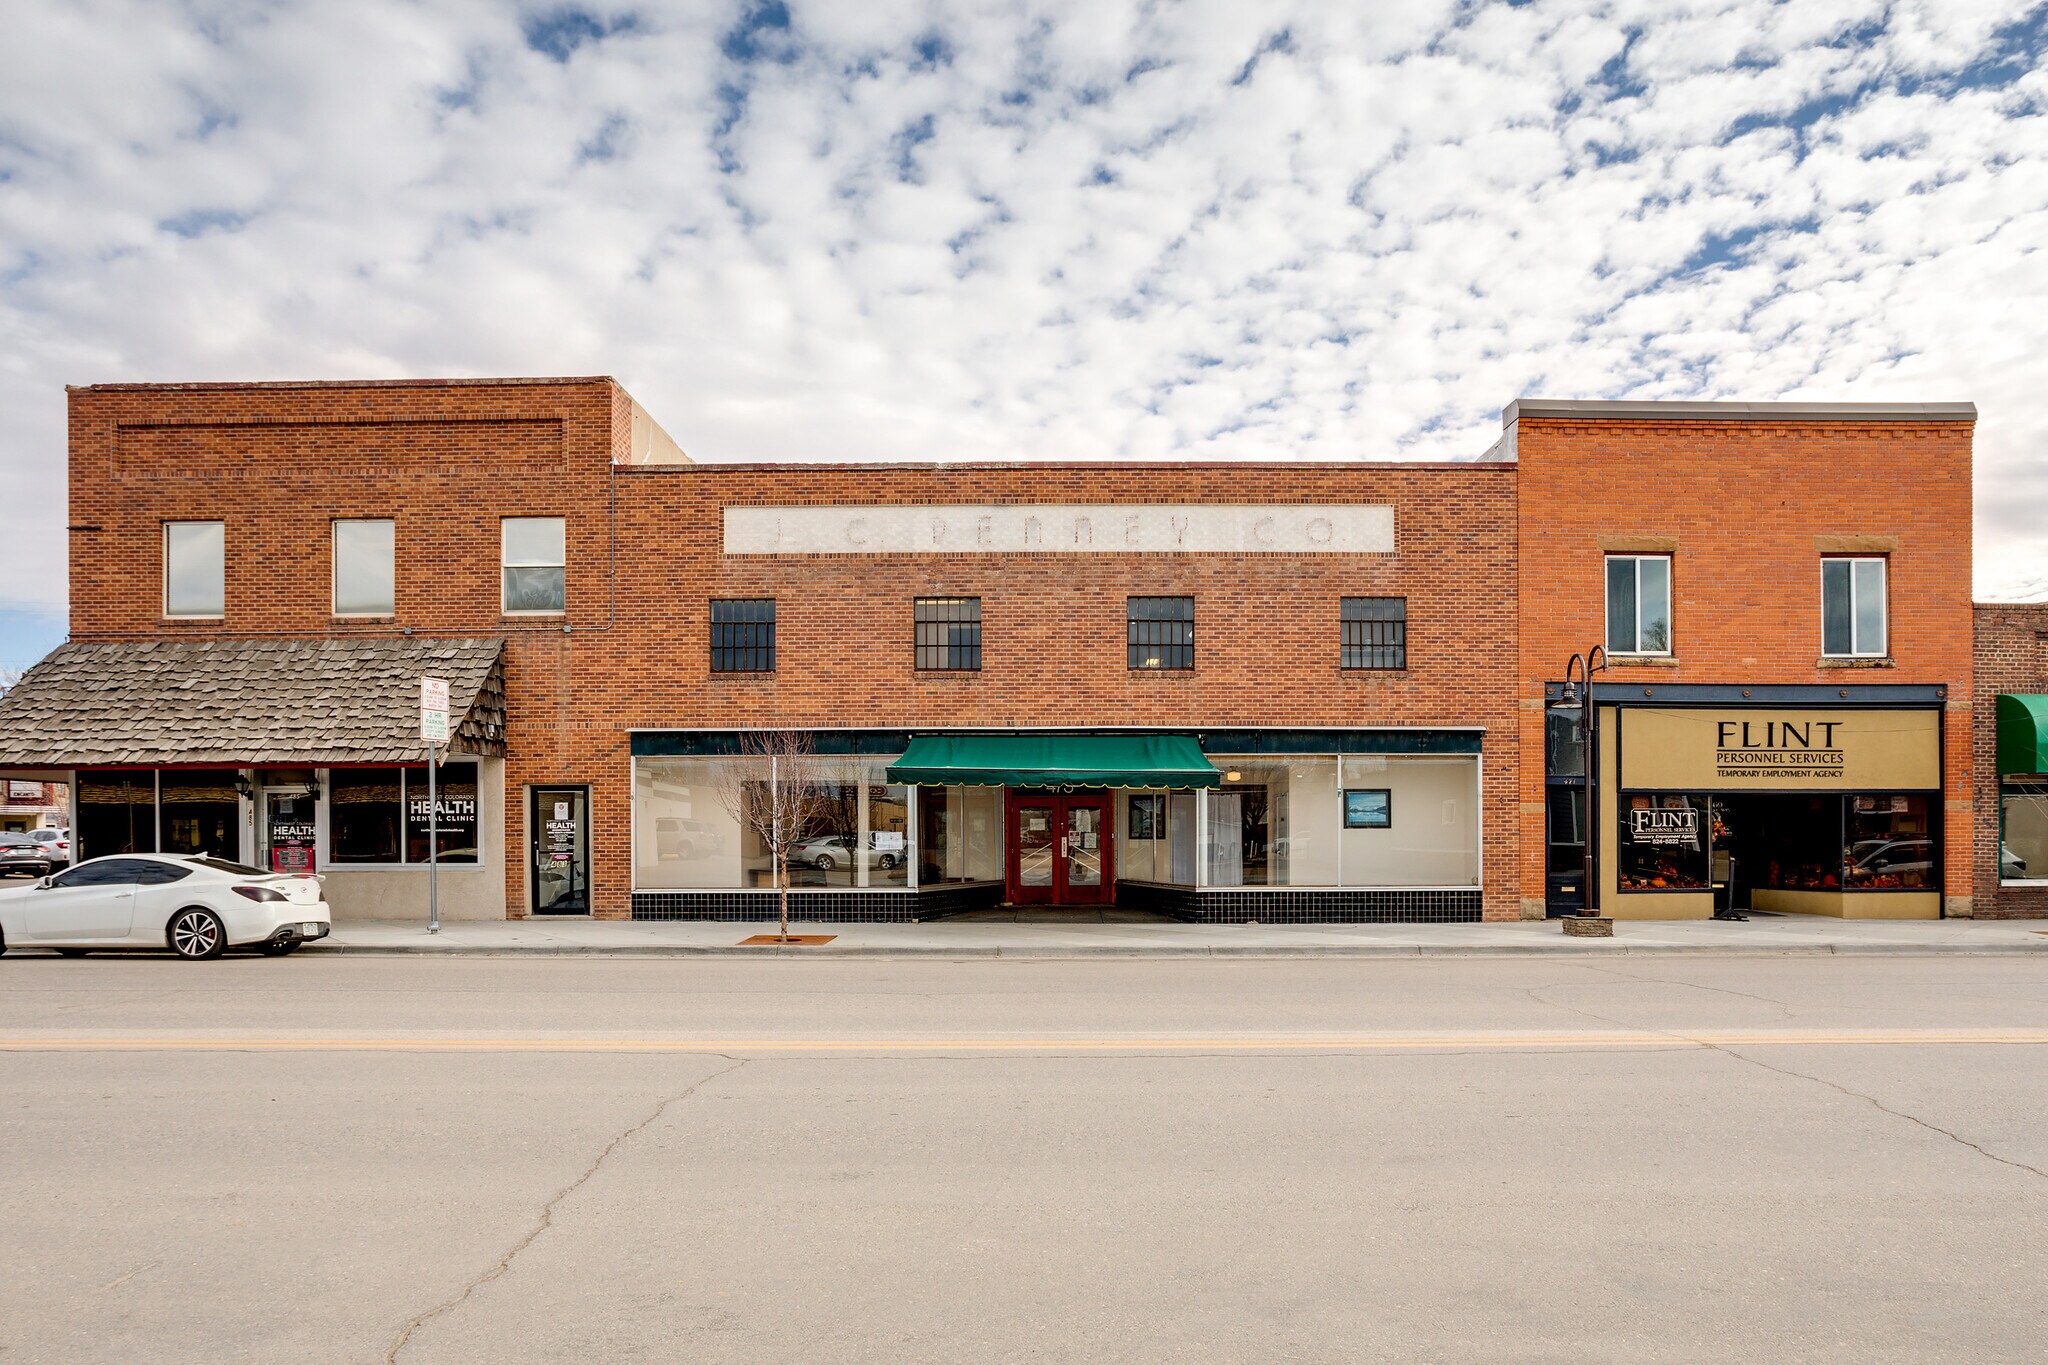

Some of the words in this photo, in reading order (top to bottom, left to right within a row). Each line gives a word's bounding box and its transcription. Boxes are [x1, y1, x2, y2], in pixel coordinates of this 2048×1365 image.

[930, 514, 1188, 544] PENNEY
[425, 689, 445, 697] PARKING
[1717, 721, 1844, 748] FLINT
[1716, 753, 1786, 763] PERSONNEL
[1789, 753, 1844, 763] SERVICES
[410, 800, 475, 814] HEALTH
[1633, 810, 1696, 833] FLINT
[273, 825, 316, 835] HEALTH
